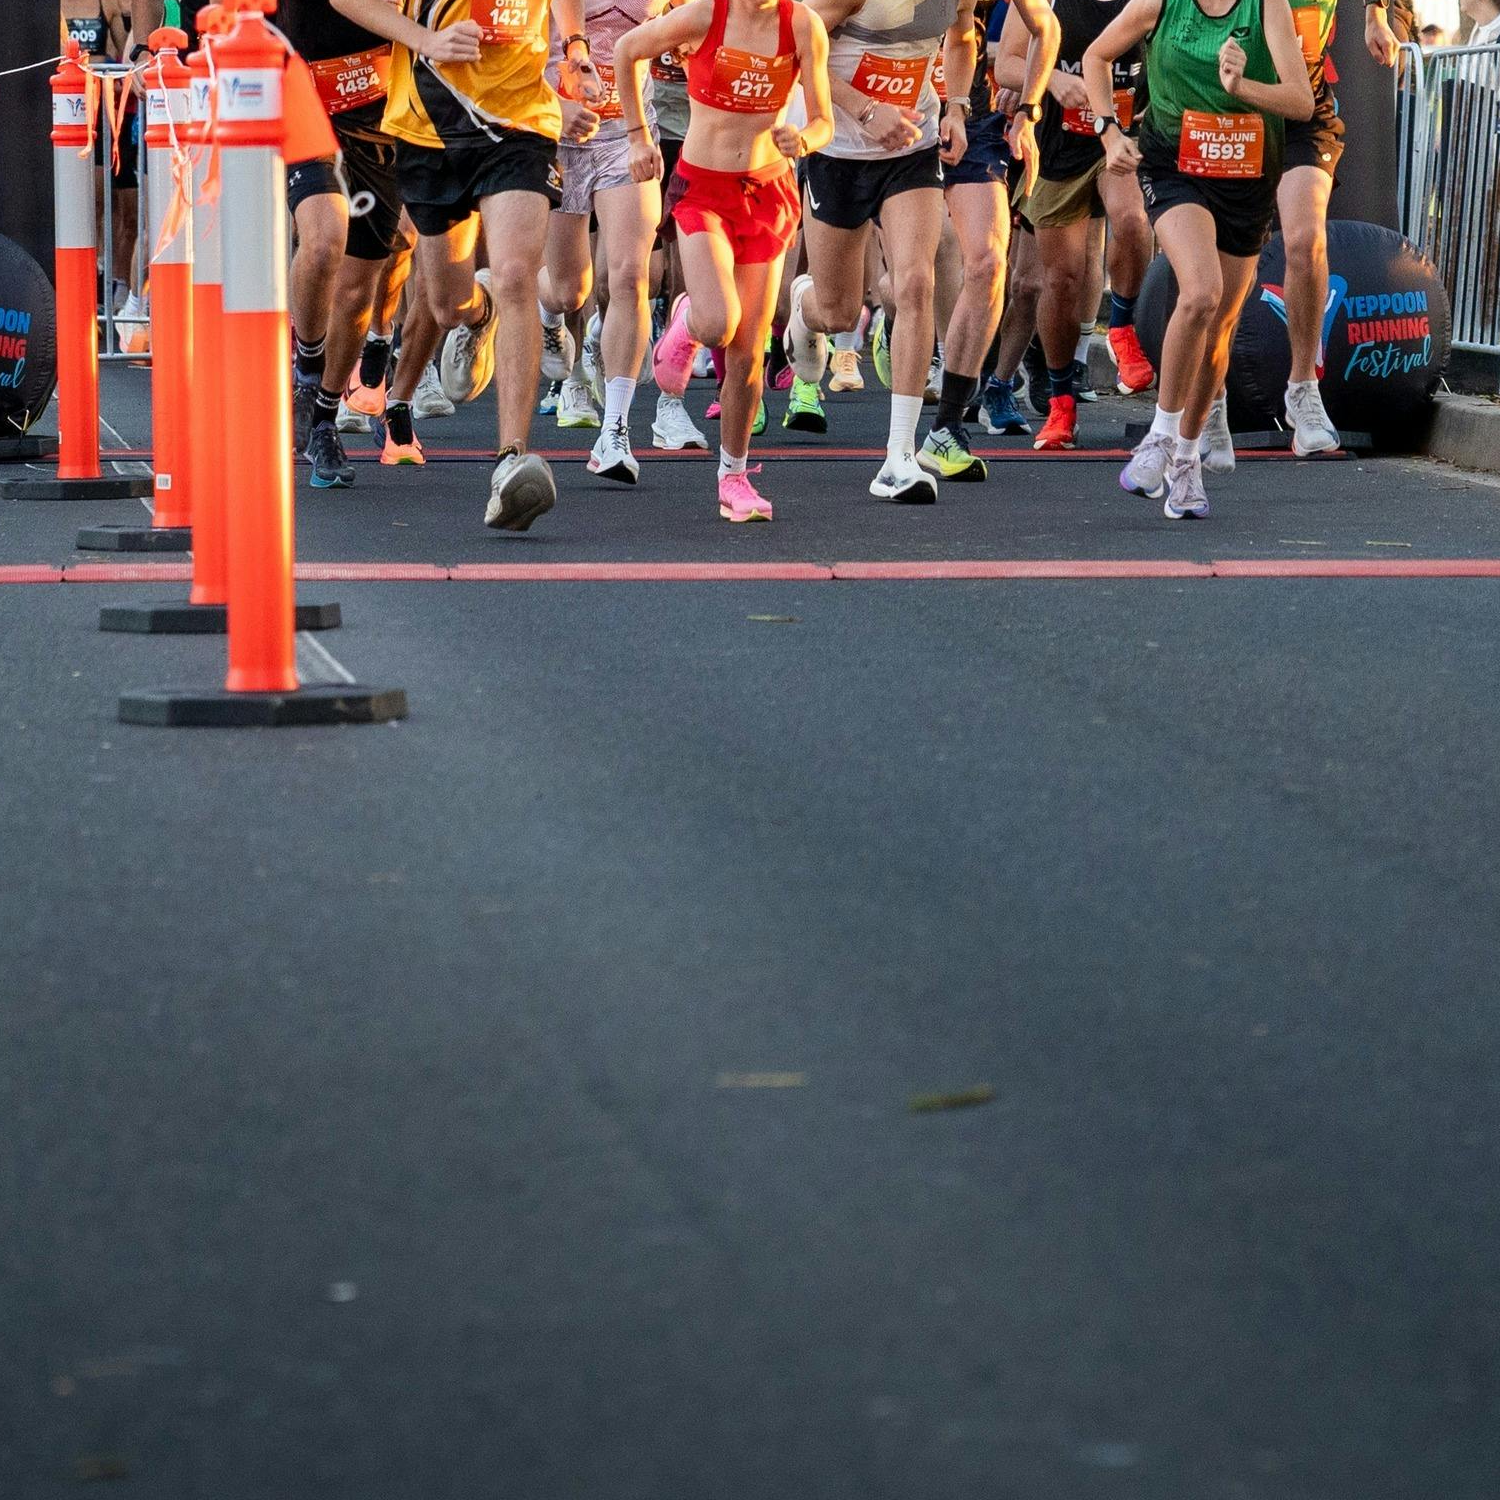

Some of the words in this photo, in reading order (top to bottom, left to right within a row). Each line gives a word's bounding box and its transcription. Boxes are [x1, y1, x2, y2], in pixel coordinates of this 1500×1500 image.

[490, 8, 529, 26] 1421
[69, 30, 97, 42] 009
[336, 65, 375, 82] CURTIS
[740, 70, 769, 82] AYLA
[1060, 60, 1142, 77] MLE
[336, 72, 380, 96] 1484
[731, 79, 775, 98] 1217
[866, 73, 915, 95] 1702
[1189, 129, 1257, 142] SHYLA-JUNE
[1198, 142, 1246, 160] 1593
[1343, 290, 1429, 318] YEPPOON
[1347, 315, 1431, 345] RUNNING
[1343, 333, 1435, 382] Festival
